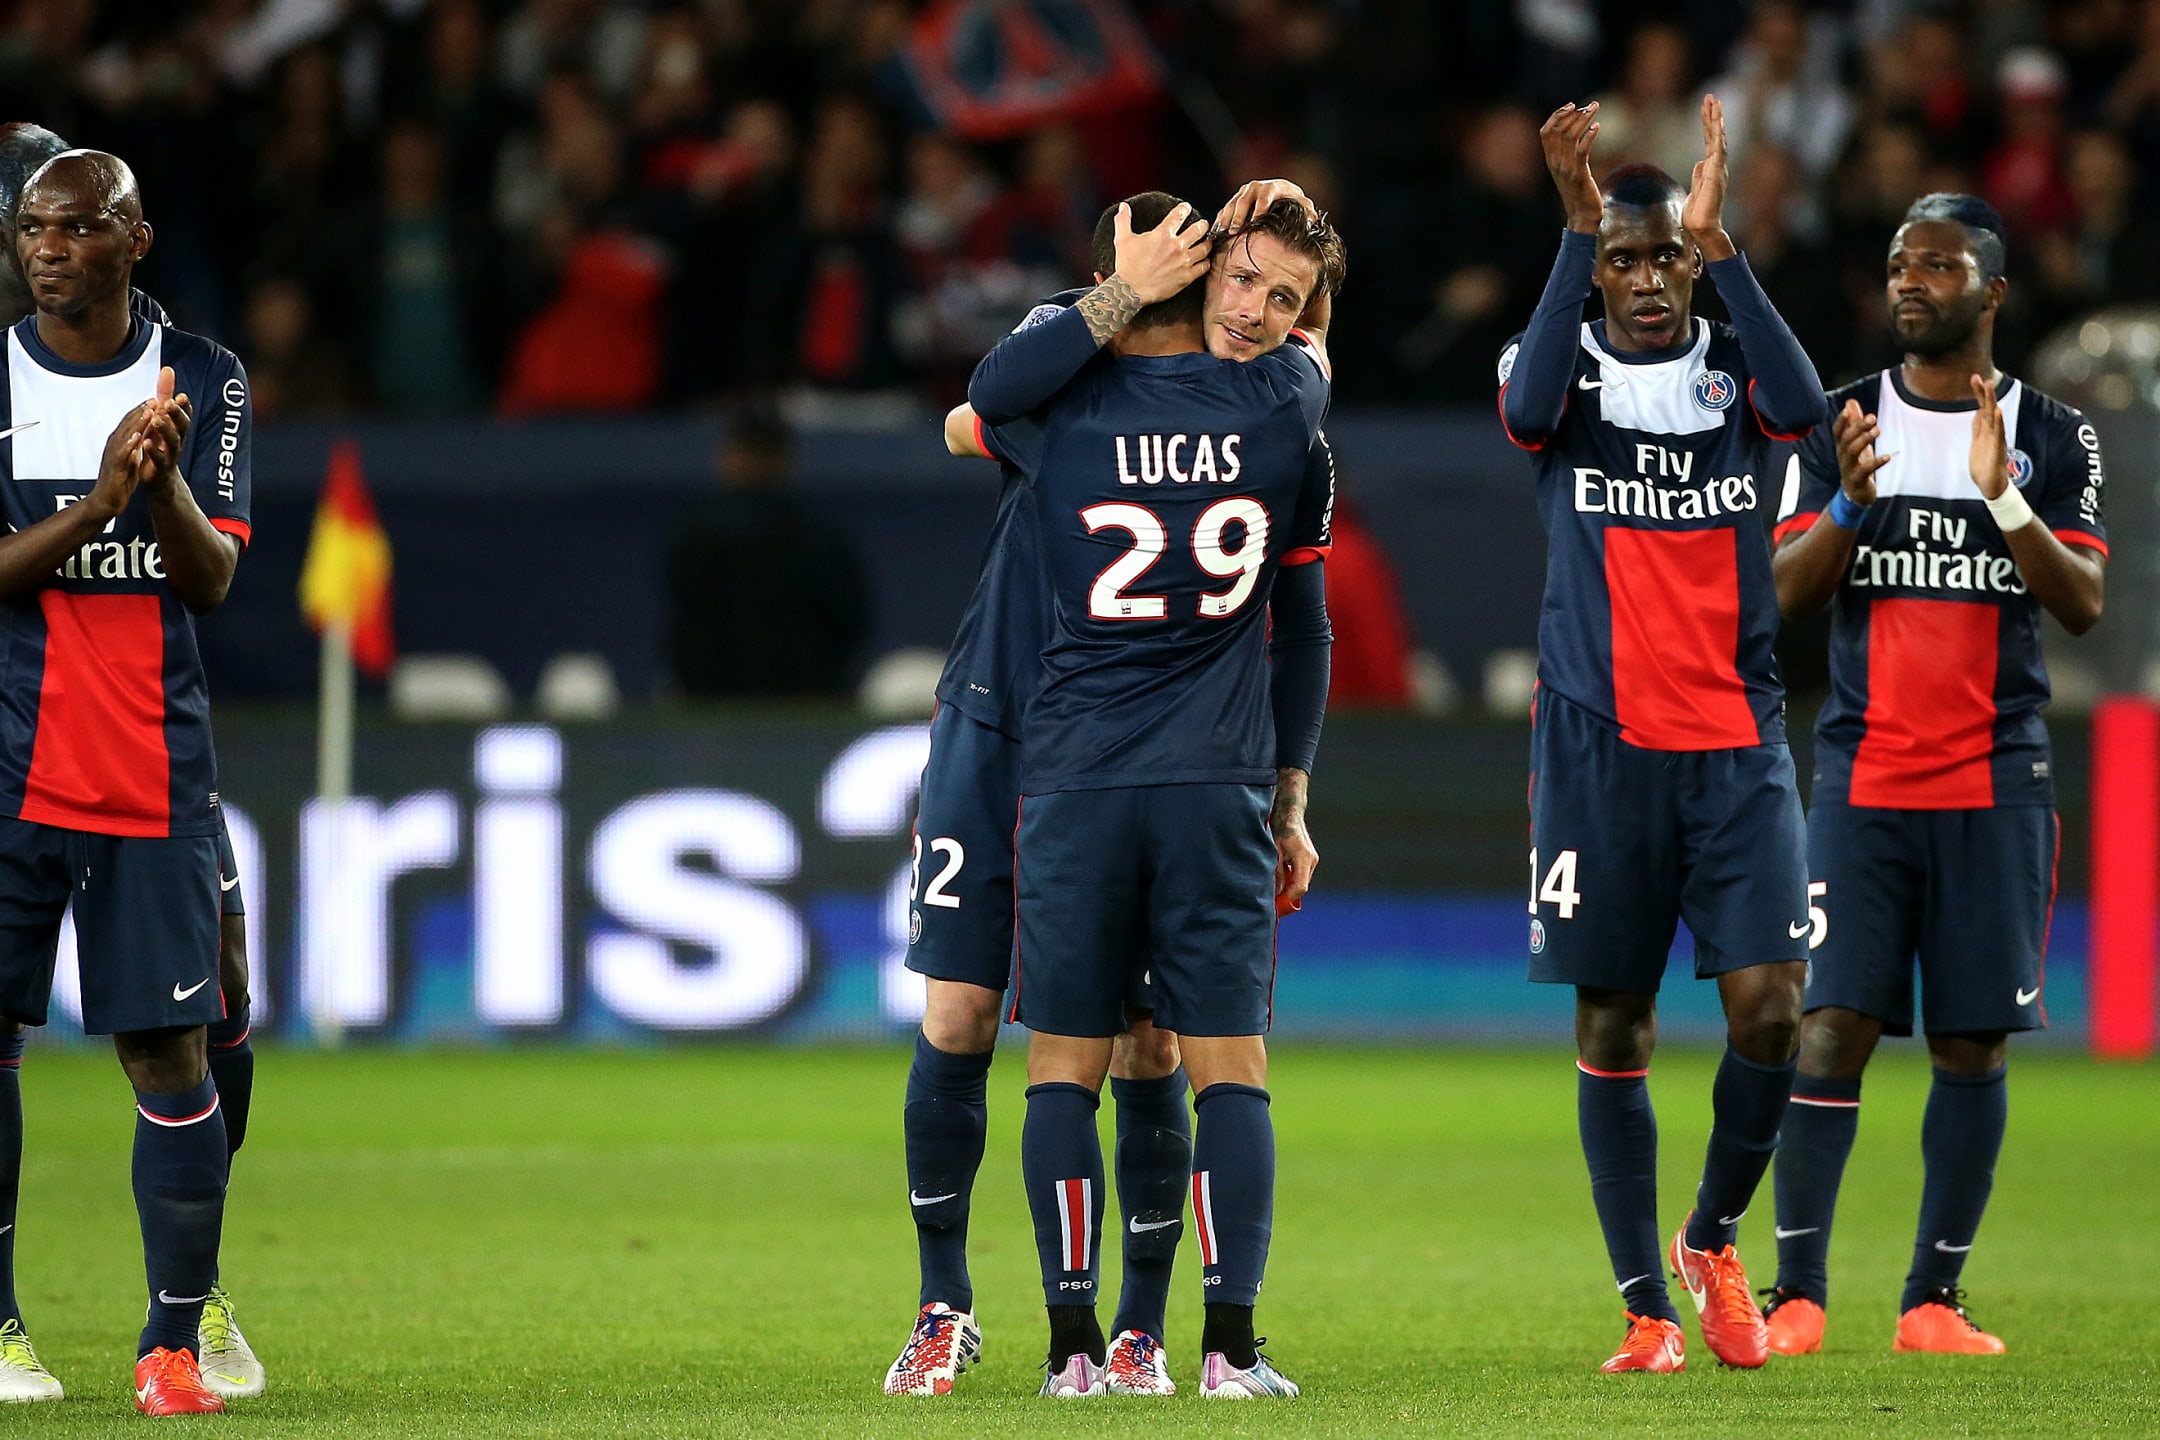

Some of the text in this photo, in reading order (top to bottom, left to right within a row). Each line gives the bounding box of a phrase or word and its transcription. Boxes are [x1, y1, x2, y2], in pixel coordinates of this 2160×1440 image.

[1115, 433, 1241, 485] LUCAS
[1635, 443, 1694, 483] Fly
[1572, 467, 1757, 521] Emirates
[1908, 507, 1968, 550] Fly
[1079, 496, 1271, 620] 29
[1528, 846, 1581, 919] 14
[1059, 1280, 1093, 1291] PSG
[1202, 1275, 1222, 1287] SG
